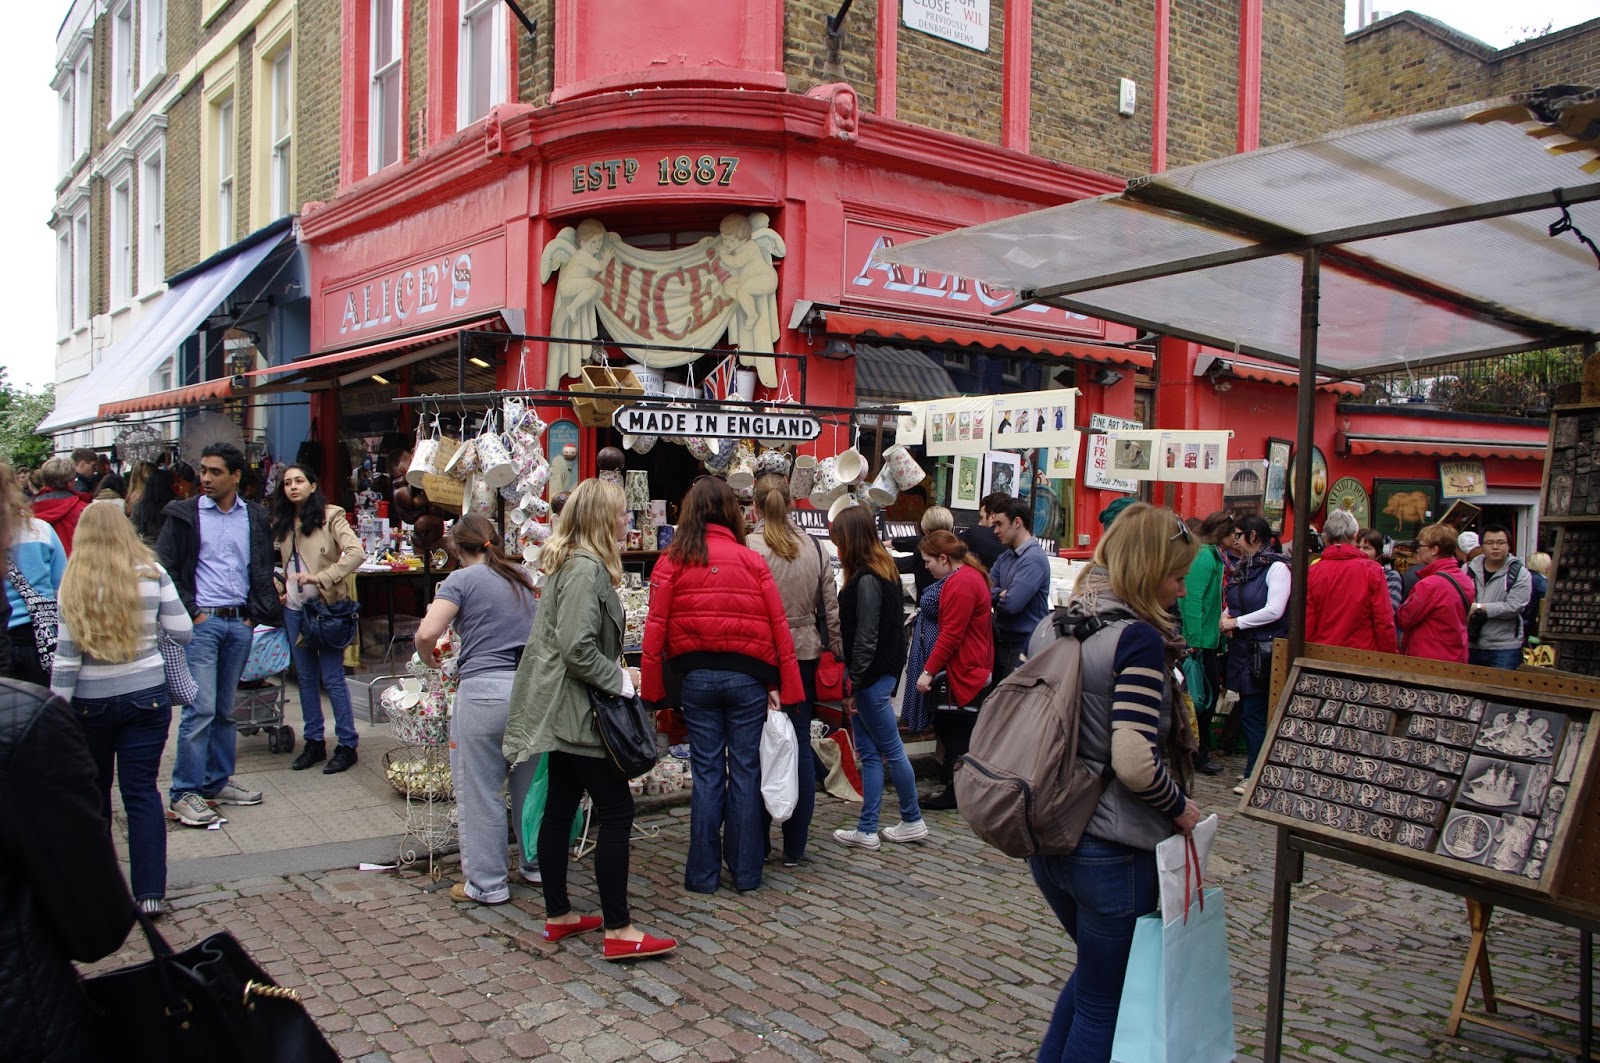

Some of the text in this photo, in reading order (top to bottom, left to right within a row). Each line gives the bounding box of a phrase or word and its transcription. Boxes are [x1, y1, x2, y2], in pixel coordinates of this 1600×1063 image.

[926, 11, 968, 31] PREVIOUSLY
[919, 19, 974, 44] DENBIGH MEWS
[658, 154, 740, 187] 1887
[339, 249, 472, 334] ALICE'S
[629, 411, 686, 431] MADE
[695, 414, 717, 432] IN
[727, 416, 813, 436] ENGLAND
[1093, 416, 1106, 429] FINE
[1108, 418, 1120, 430] ART
[1442, 462, 1482, 476] BUTCHER
[791, 511, 824, 527] FLORAL
[886, 524, 917, 538] LONDON
